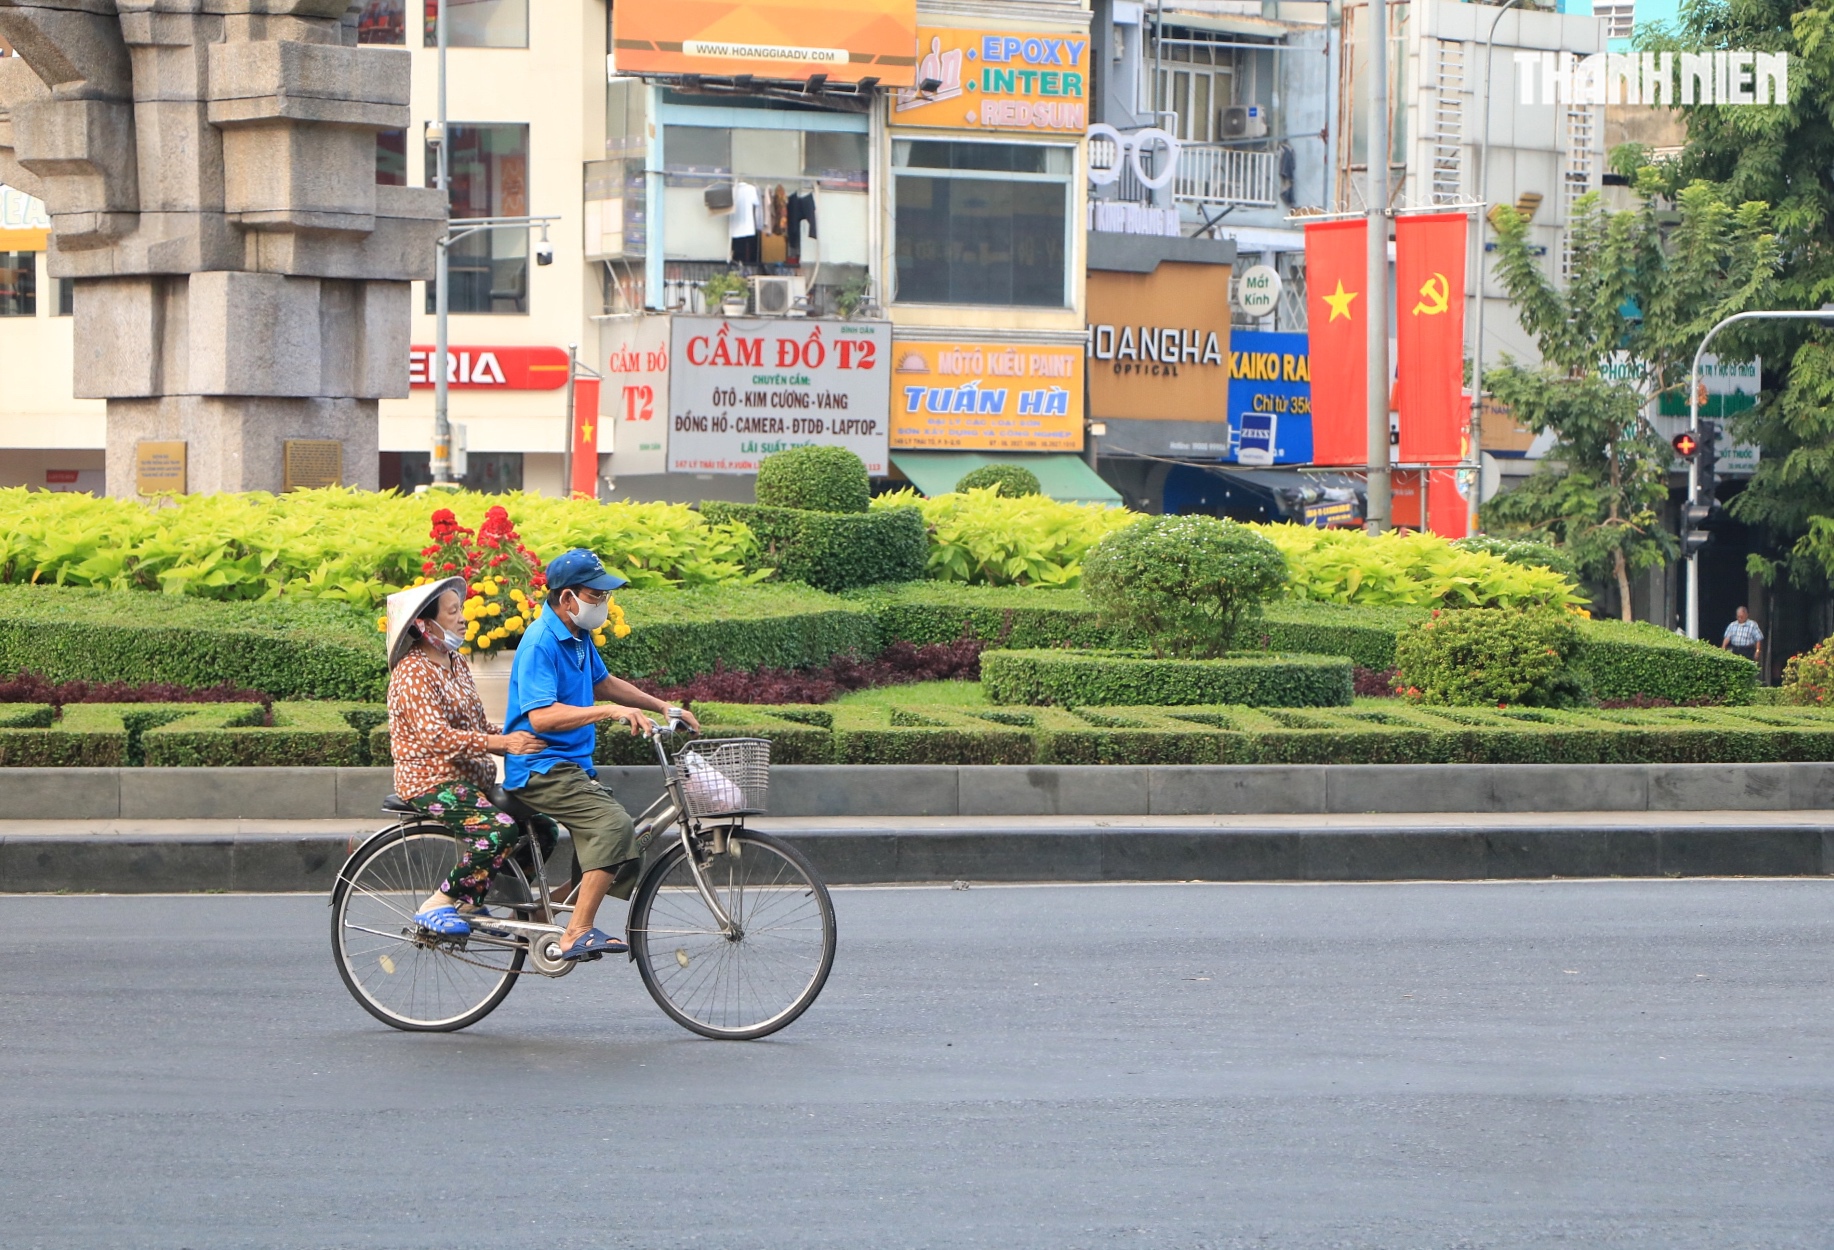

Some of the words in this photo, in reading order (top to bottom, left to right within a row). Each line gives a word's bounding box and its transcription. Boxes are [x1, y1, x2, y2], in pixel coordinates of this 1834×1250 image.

[696, 44, 835, 61] WWW.HOANGGIAADV.COM
[982, 35, 1085, 65] EPOXY
[982, 68, 1083, 97] INTER
[981, 100, 1084, 129] REDSUN
[1247, 273, 1269, 288] Mắt
[1244, 293, 1270, 305] Kính
[833, 340, 877, 370] T2
[938, 347, 983, 376] MÔTÔ
[1029, 354, 1075, 377] PAINT
[1228, 352, 1279, 380] KAIKO
[1283, 354, 1310, 382] RA
[752, 374, 787, 385] CHUYÊN
[1114, 364, 1178, 376] OPTICAL
[622, 385, 654, 421] T2
[904, 379, 1006, 415] TUẤN
[1017, 386, 1069, 415] HÀ
[736, 417, 785, 433] CAMERA
[1242, 428, 1270, 439] ZEISS
